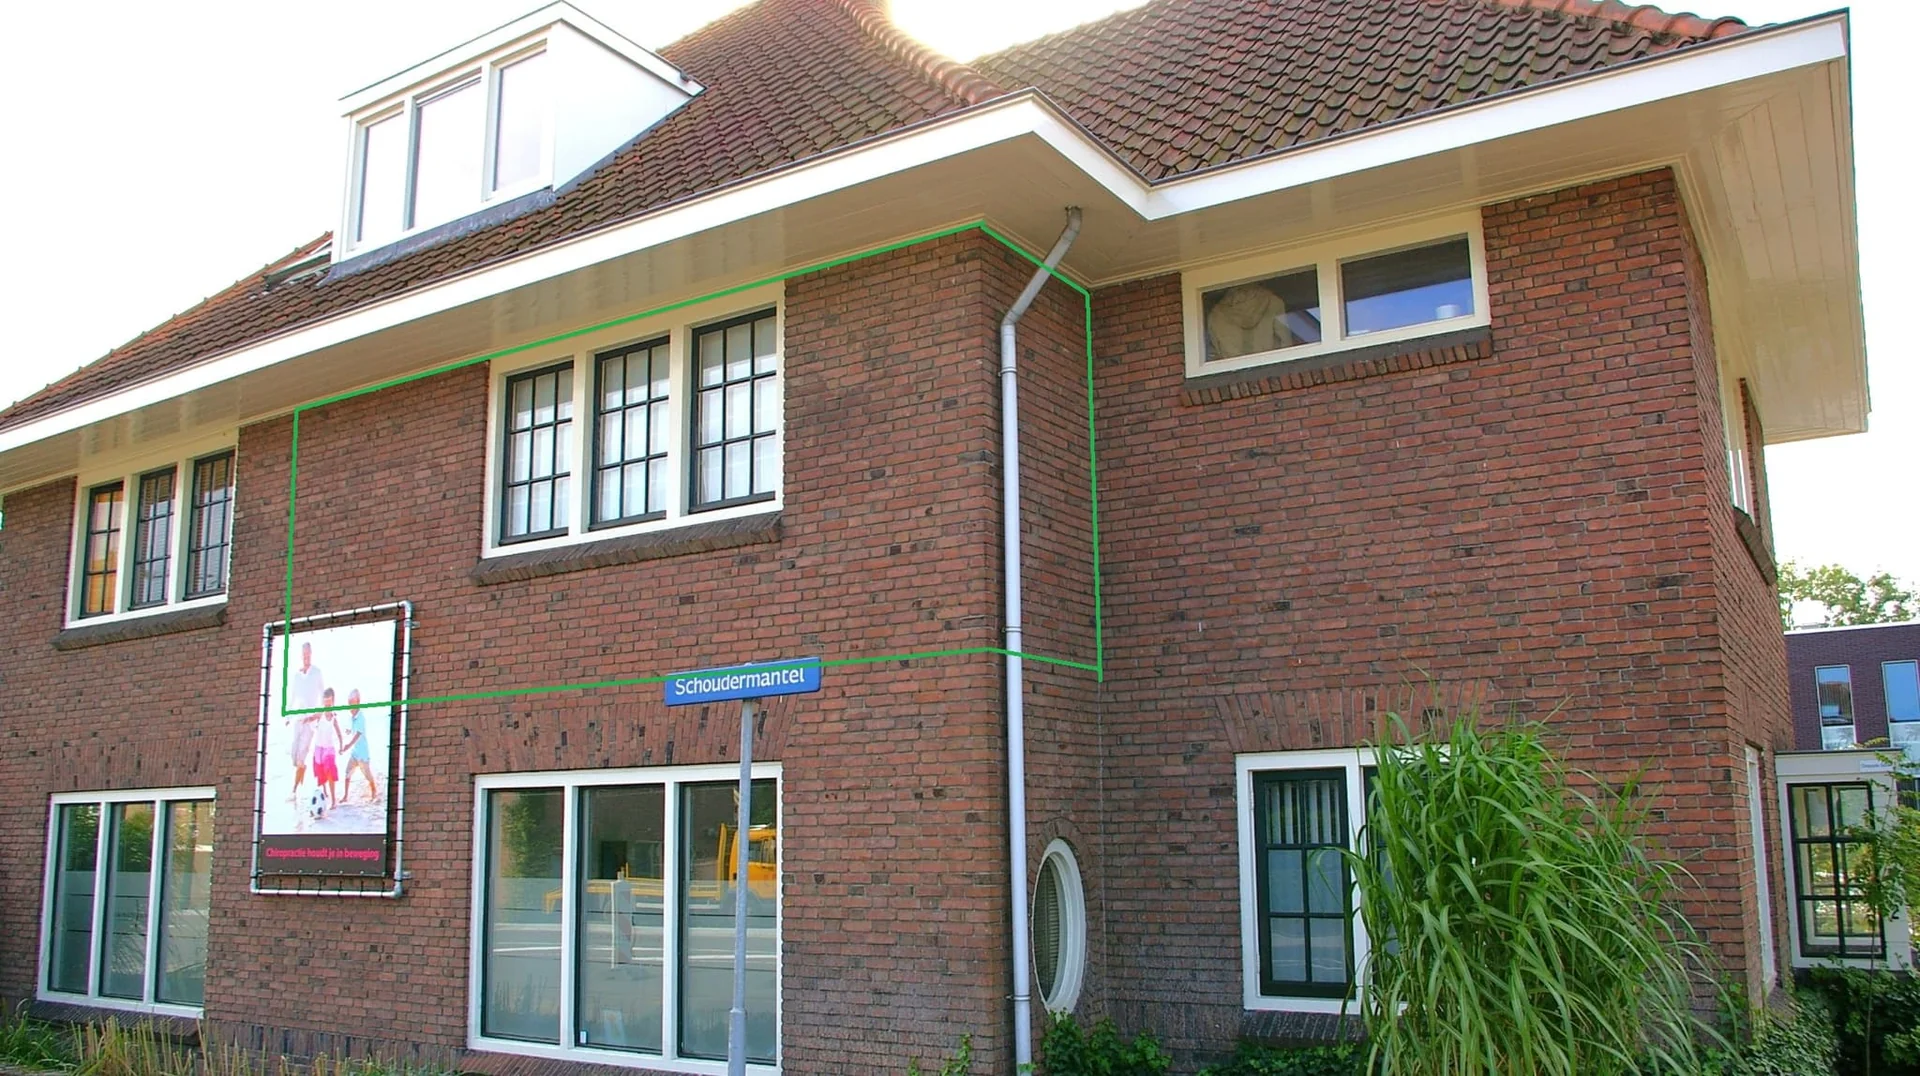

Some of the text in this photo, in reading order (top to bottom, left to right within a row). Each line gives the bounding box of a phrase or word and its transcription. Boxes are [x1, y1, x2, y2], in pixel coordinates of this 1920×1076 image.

[675, 668, 805, 695] Schoudermantel
[266, 847, 380, 861] Chiropractie houdt je in beweging
